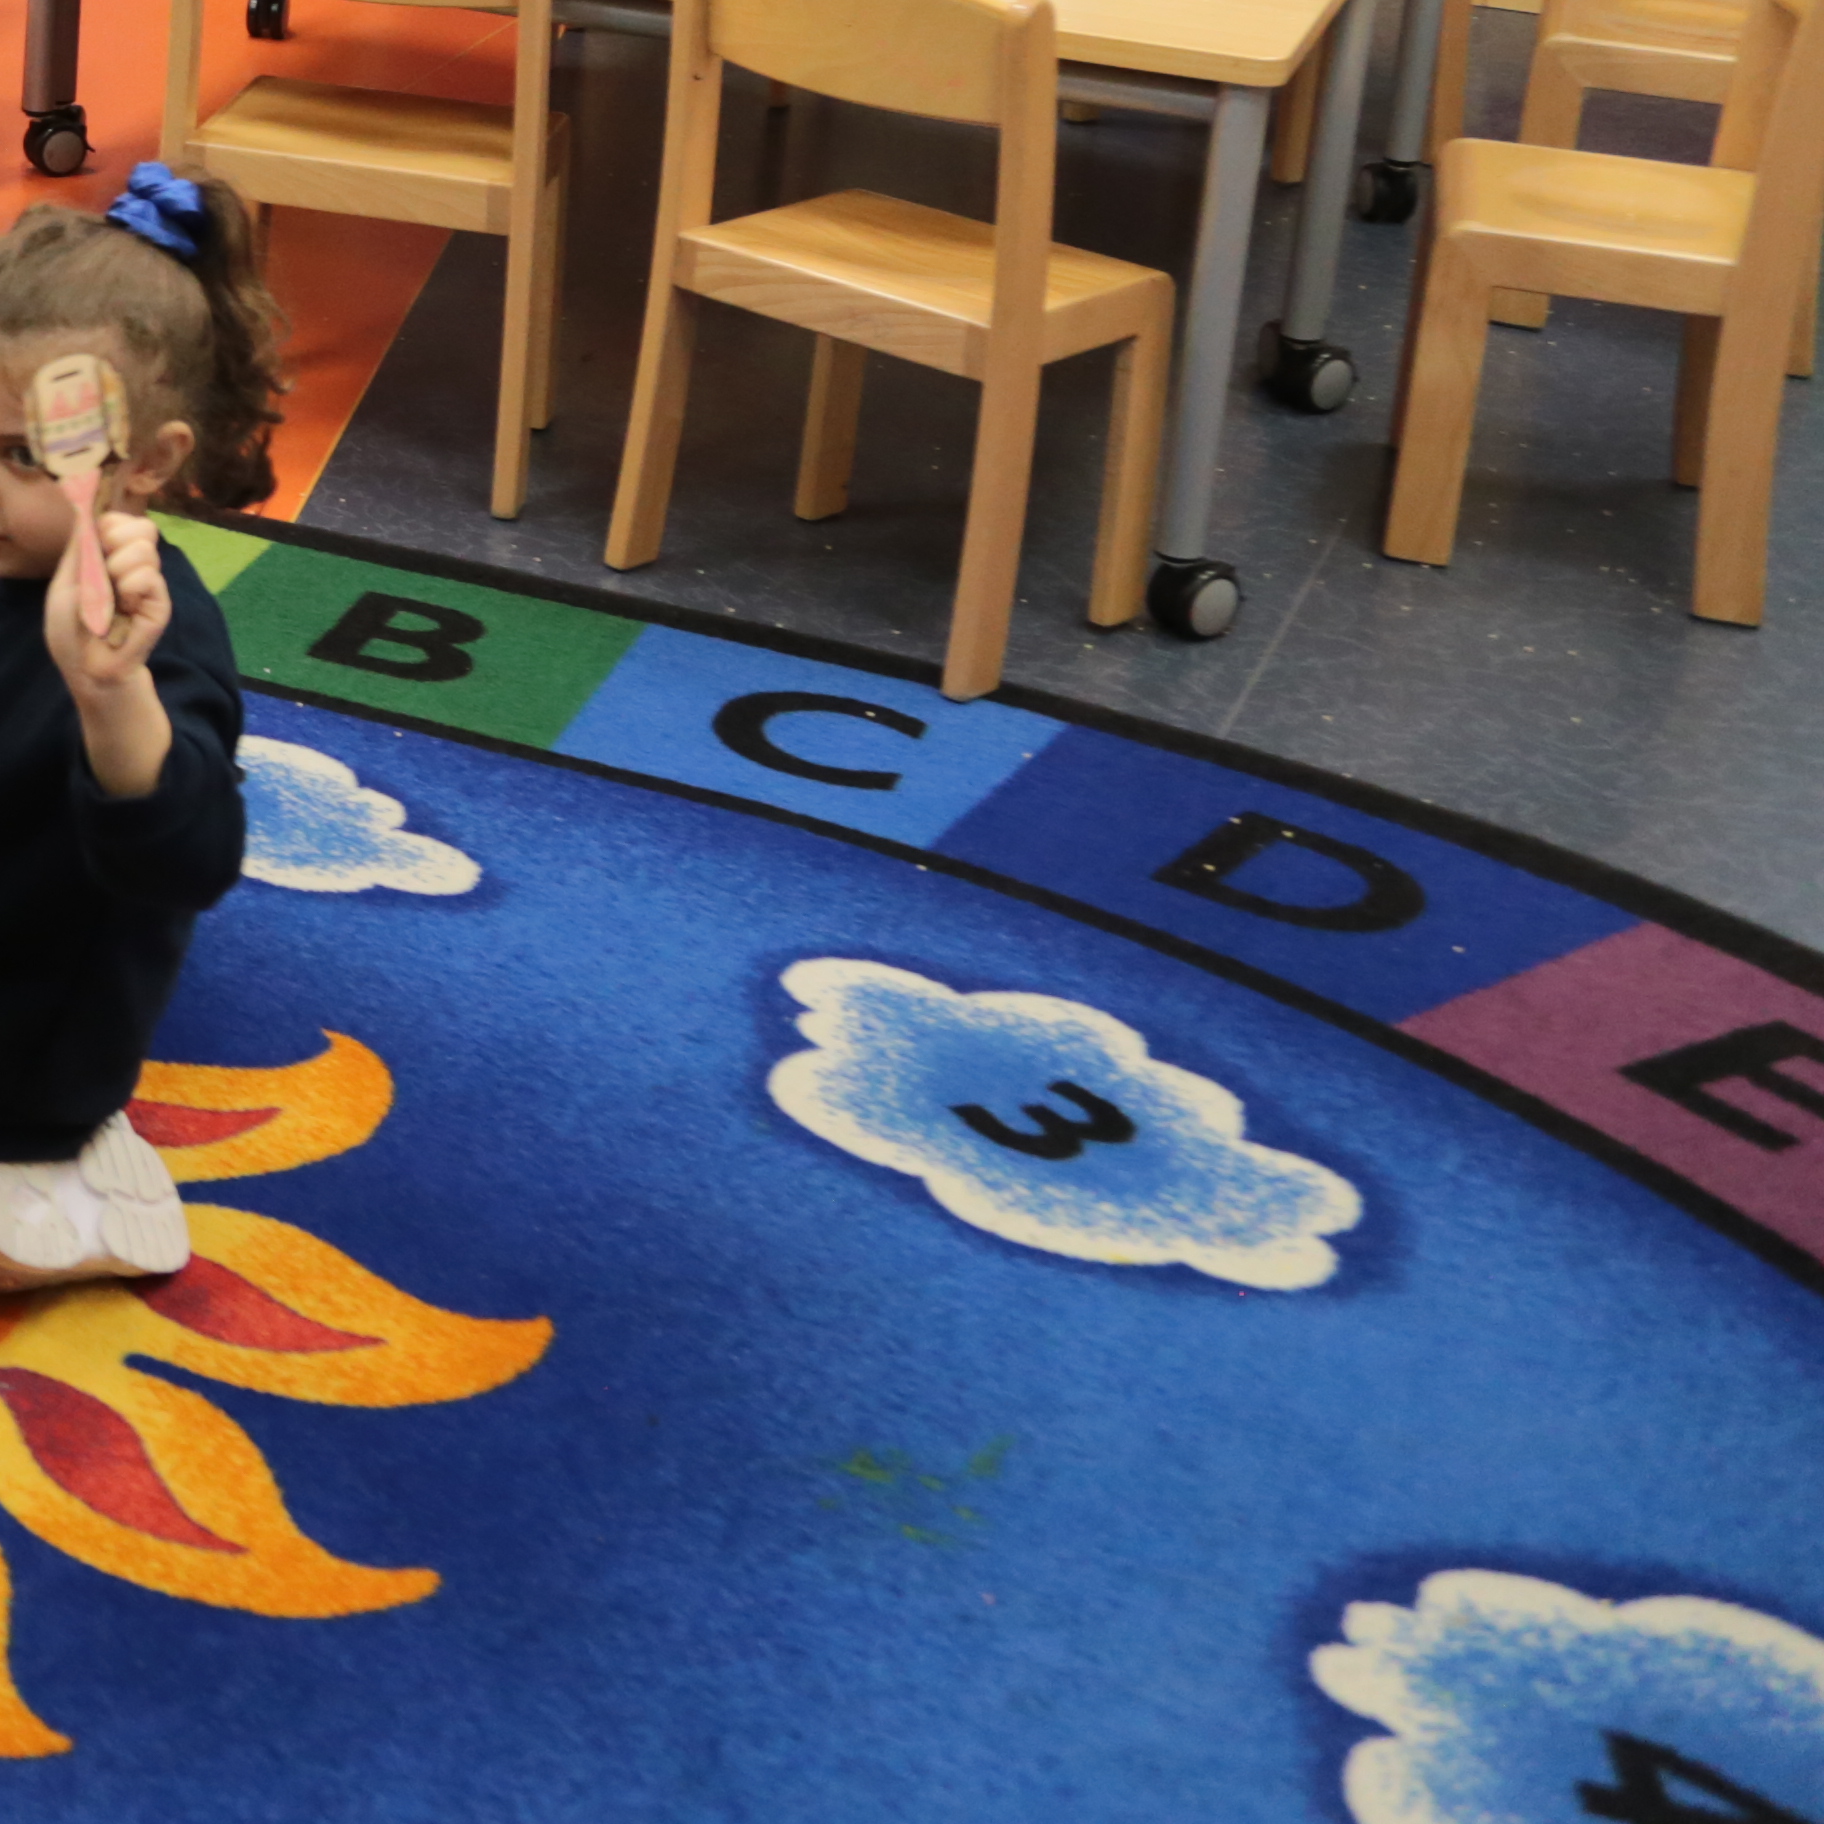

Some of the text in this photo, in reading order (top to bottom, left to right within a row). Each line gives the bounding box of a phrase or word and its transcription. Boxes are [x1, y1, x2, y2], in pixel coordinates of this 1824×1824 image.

[309, 591, 492, 683] B
[711, 691, 928, 791] C
[1154, 811, 1426, 934] D
[949, 1079, 1139, 1162] 3
[1617, 1020, 1824, 1153] E
